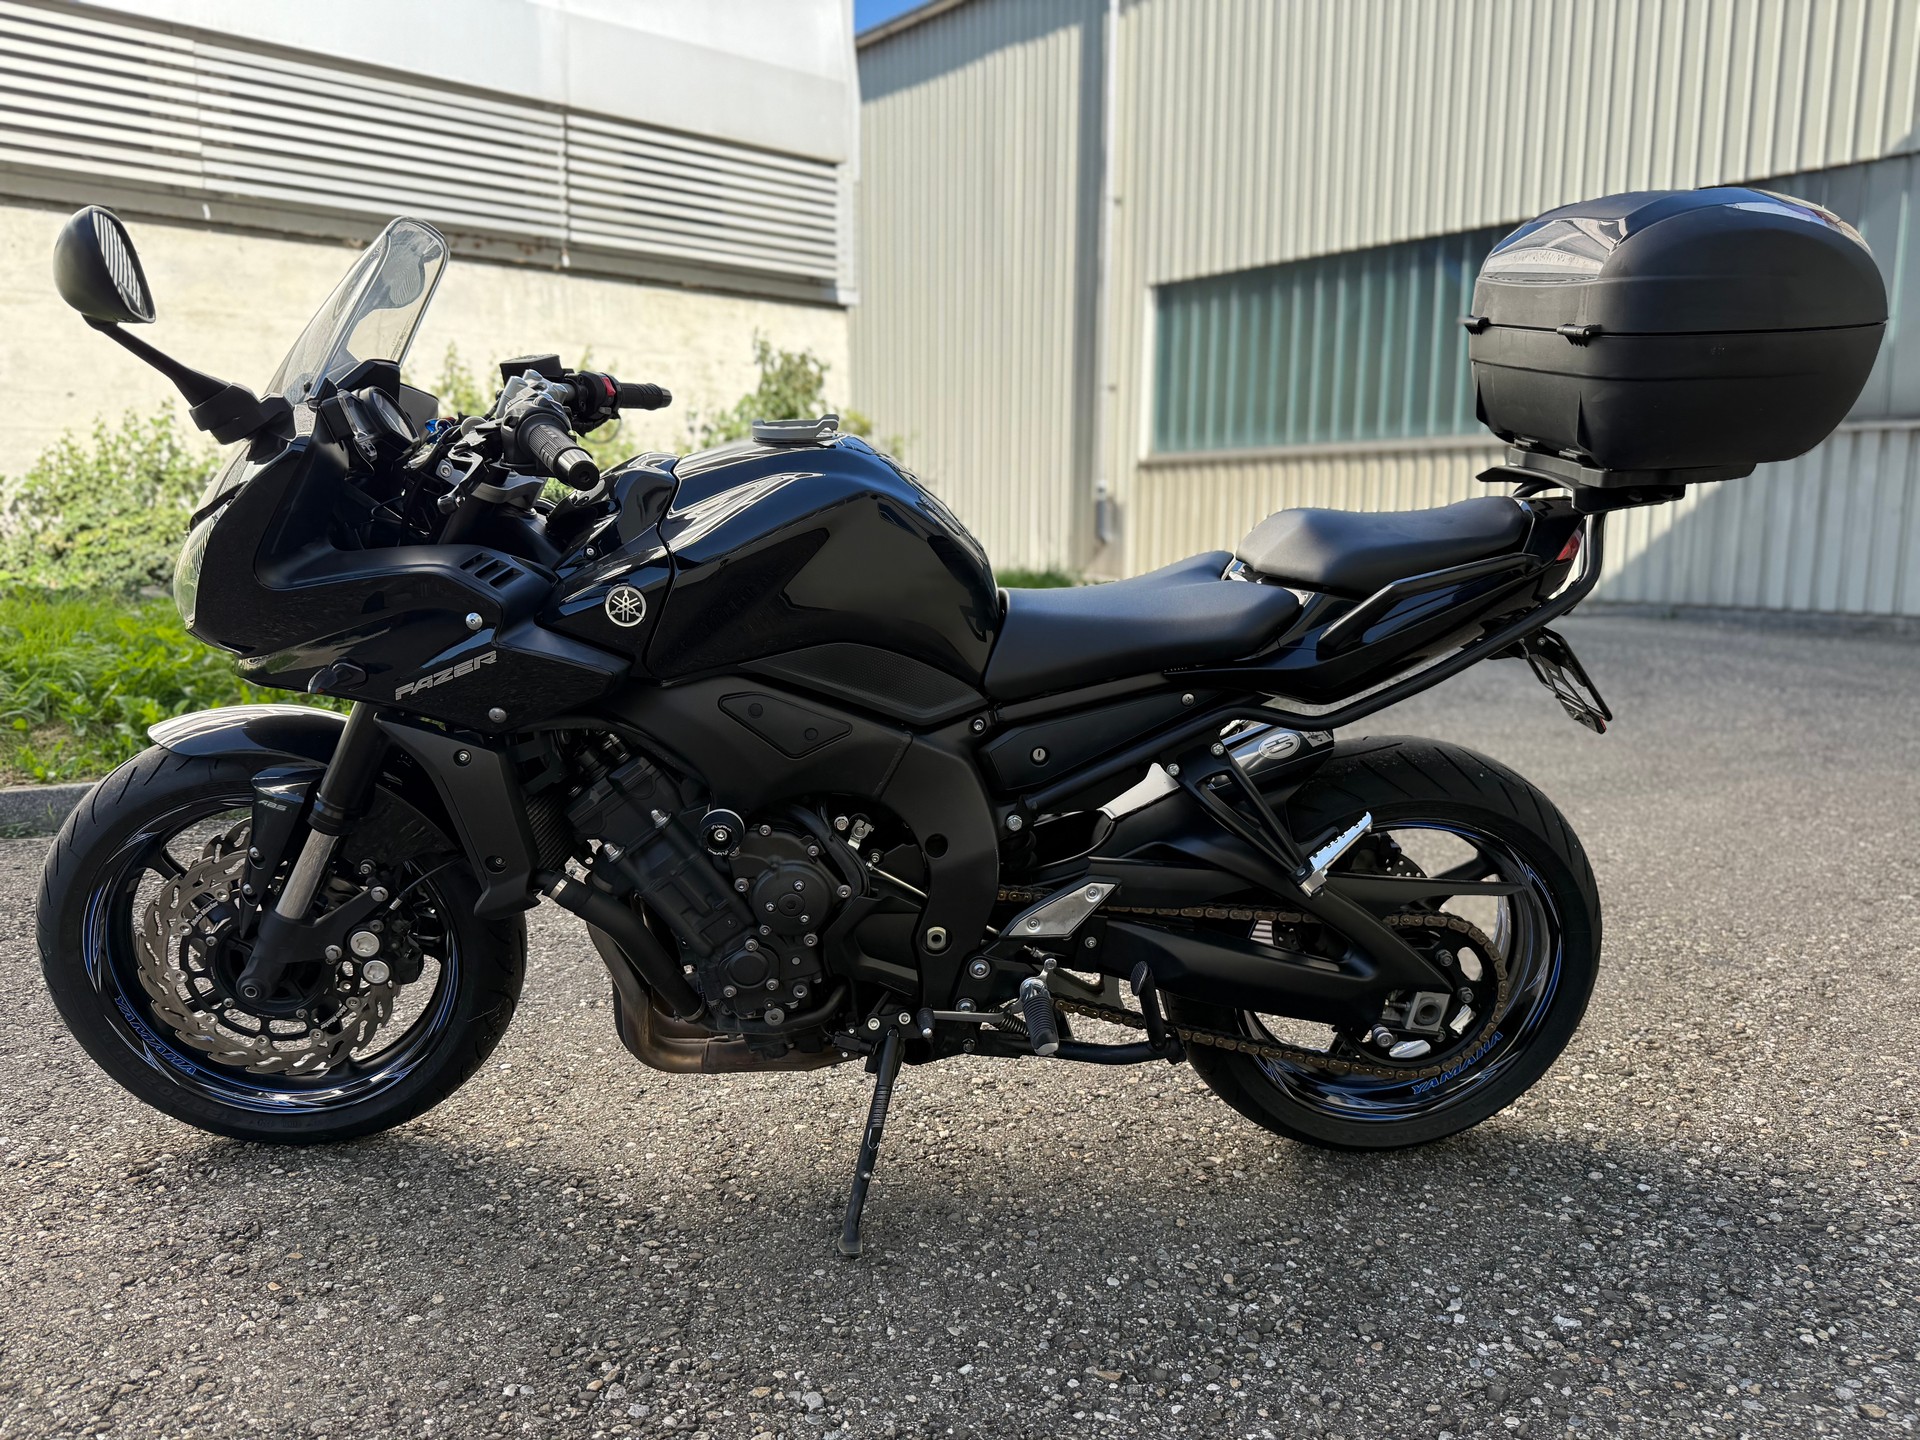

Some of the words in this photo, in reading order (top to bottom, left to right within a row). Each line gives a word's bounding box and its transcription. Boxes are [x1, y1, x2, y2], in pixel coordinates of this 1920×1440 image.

[395, 650, 497, 700] FAZER
[1264, 735, 1294, 754] CH
[257, 800, 288, 811] ABS
[114, 996, 197, 1075] YAMAHA
[1411, 1030, 1504, 1095] YAMAHA
